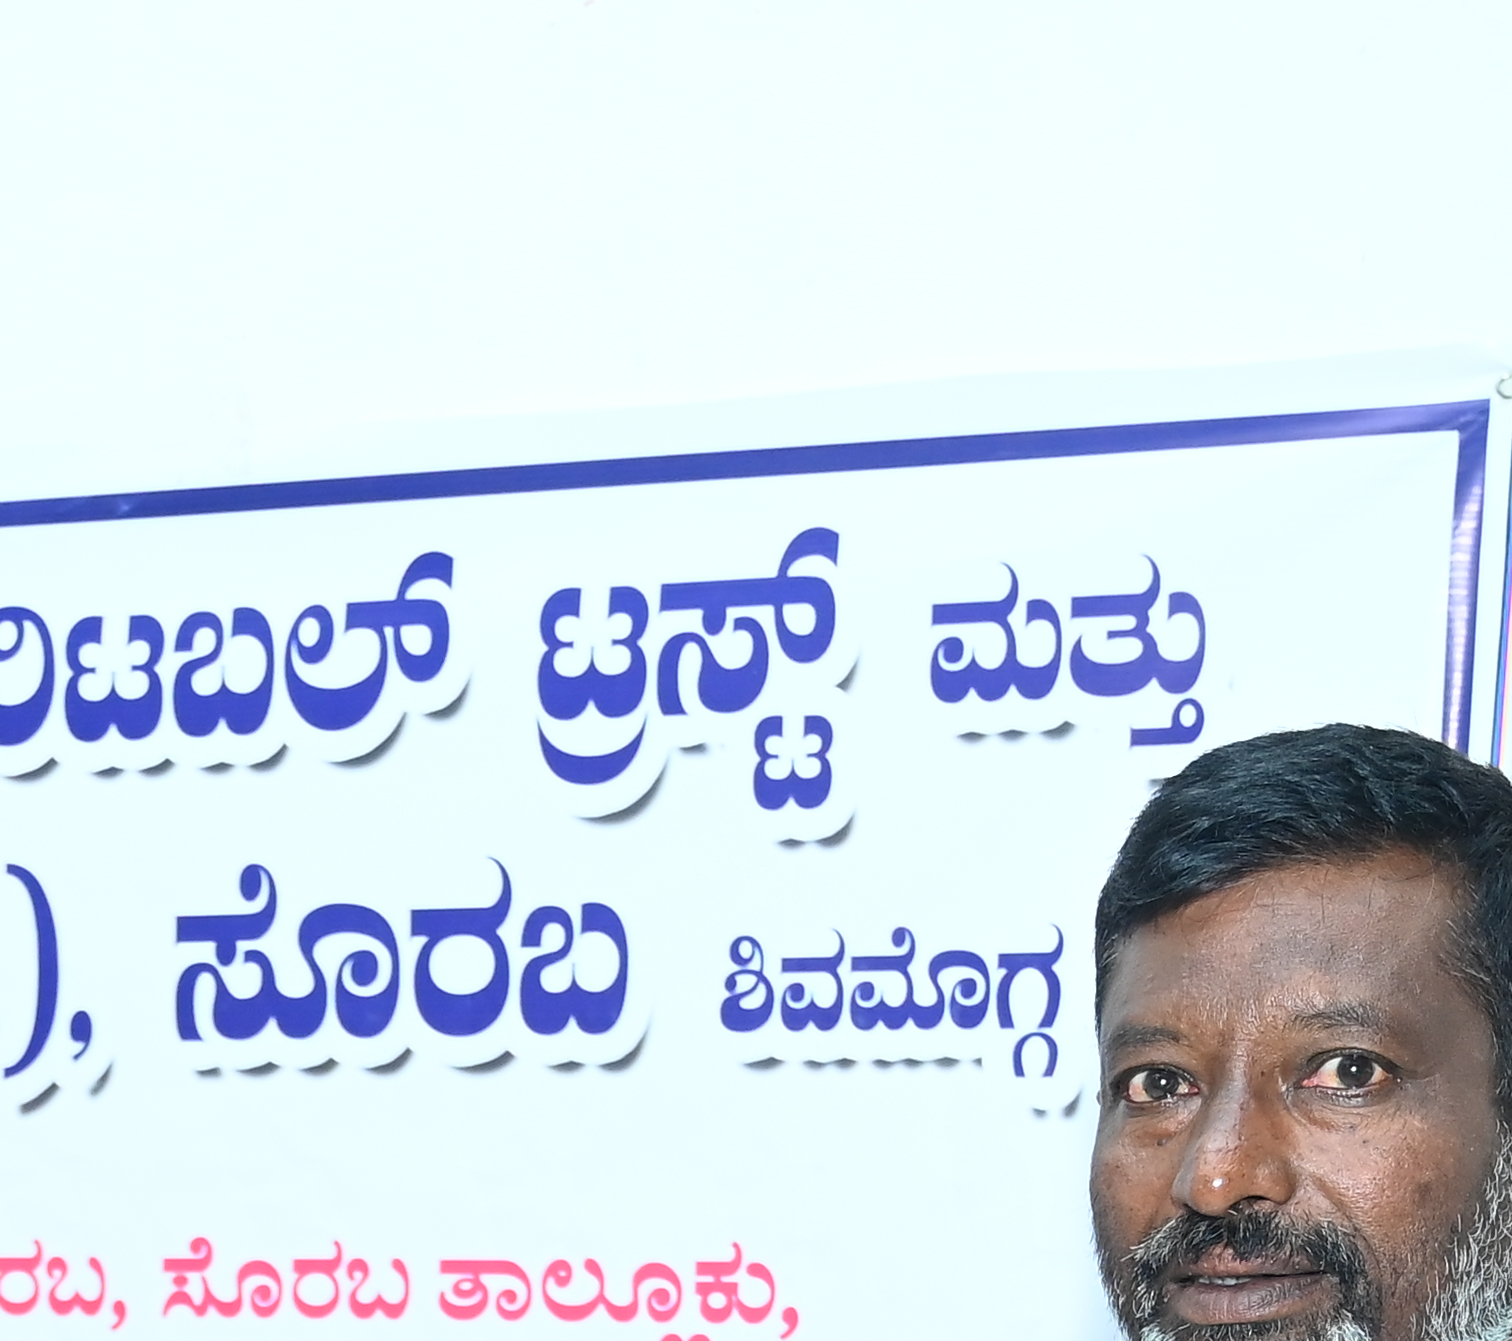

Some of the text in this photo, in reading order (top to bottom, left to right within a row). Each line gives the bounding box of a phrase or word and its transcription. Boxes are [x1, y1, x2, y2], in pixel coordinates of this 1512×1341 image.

[538, 527, 839, 810] ಟ್ರಸ್ಟ್
[931, 557, 1205, 746] ಮತ್ತು
[176, 860, 628, 1041] ಸೊರಬ
[721, 927, 1063, 1077] ಶಿವಮೊಗ್ಗ
[164, 1237, 409, 1319] ಸೊರಬ
